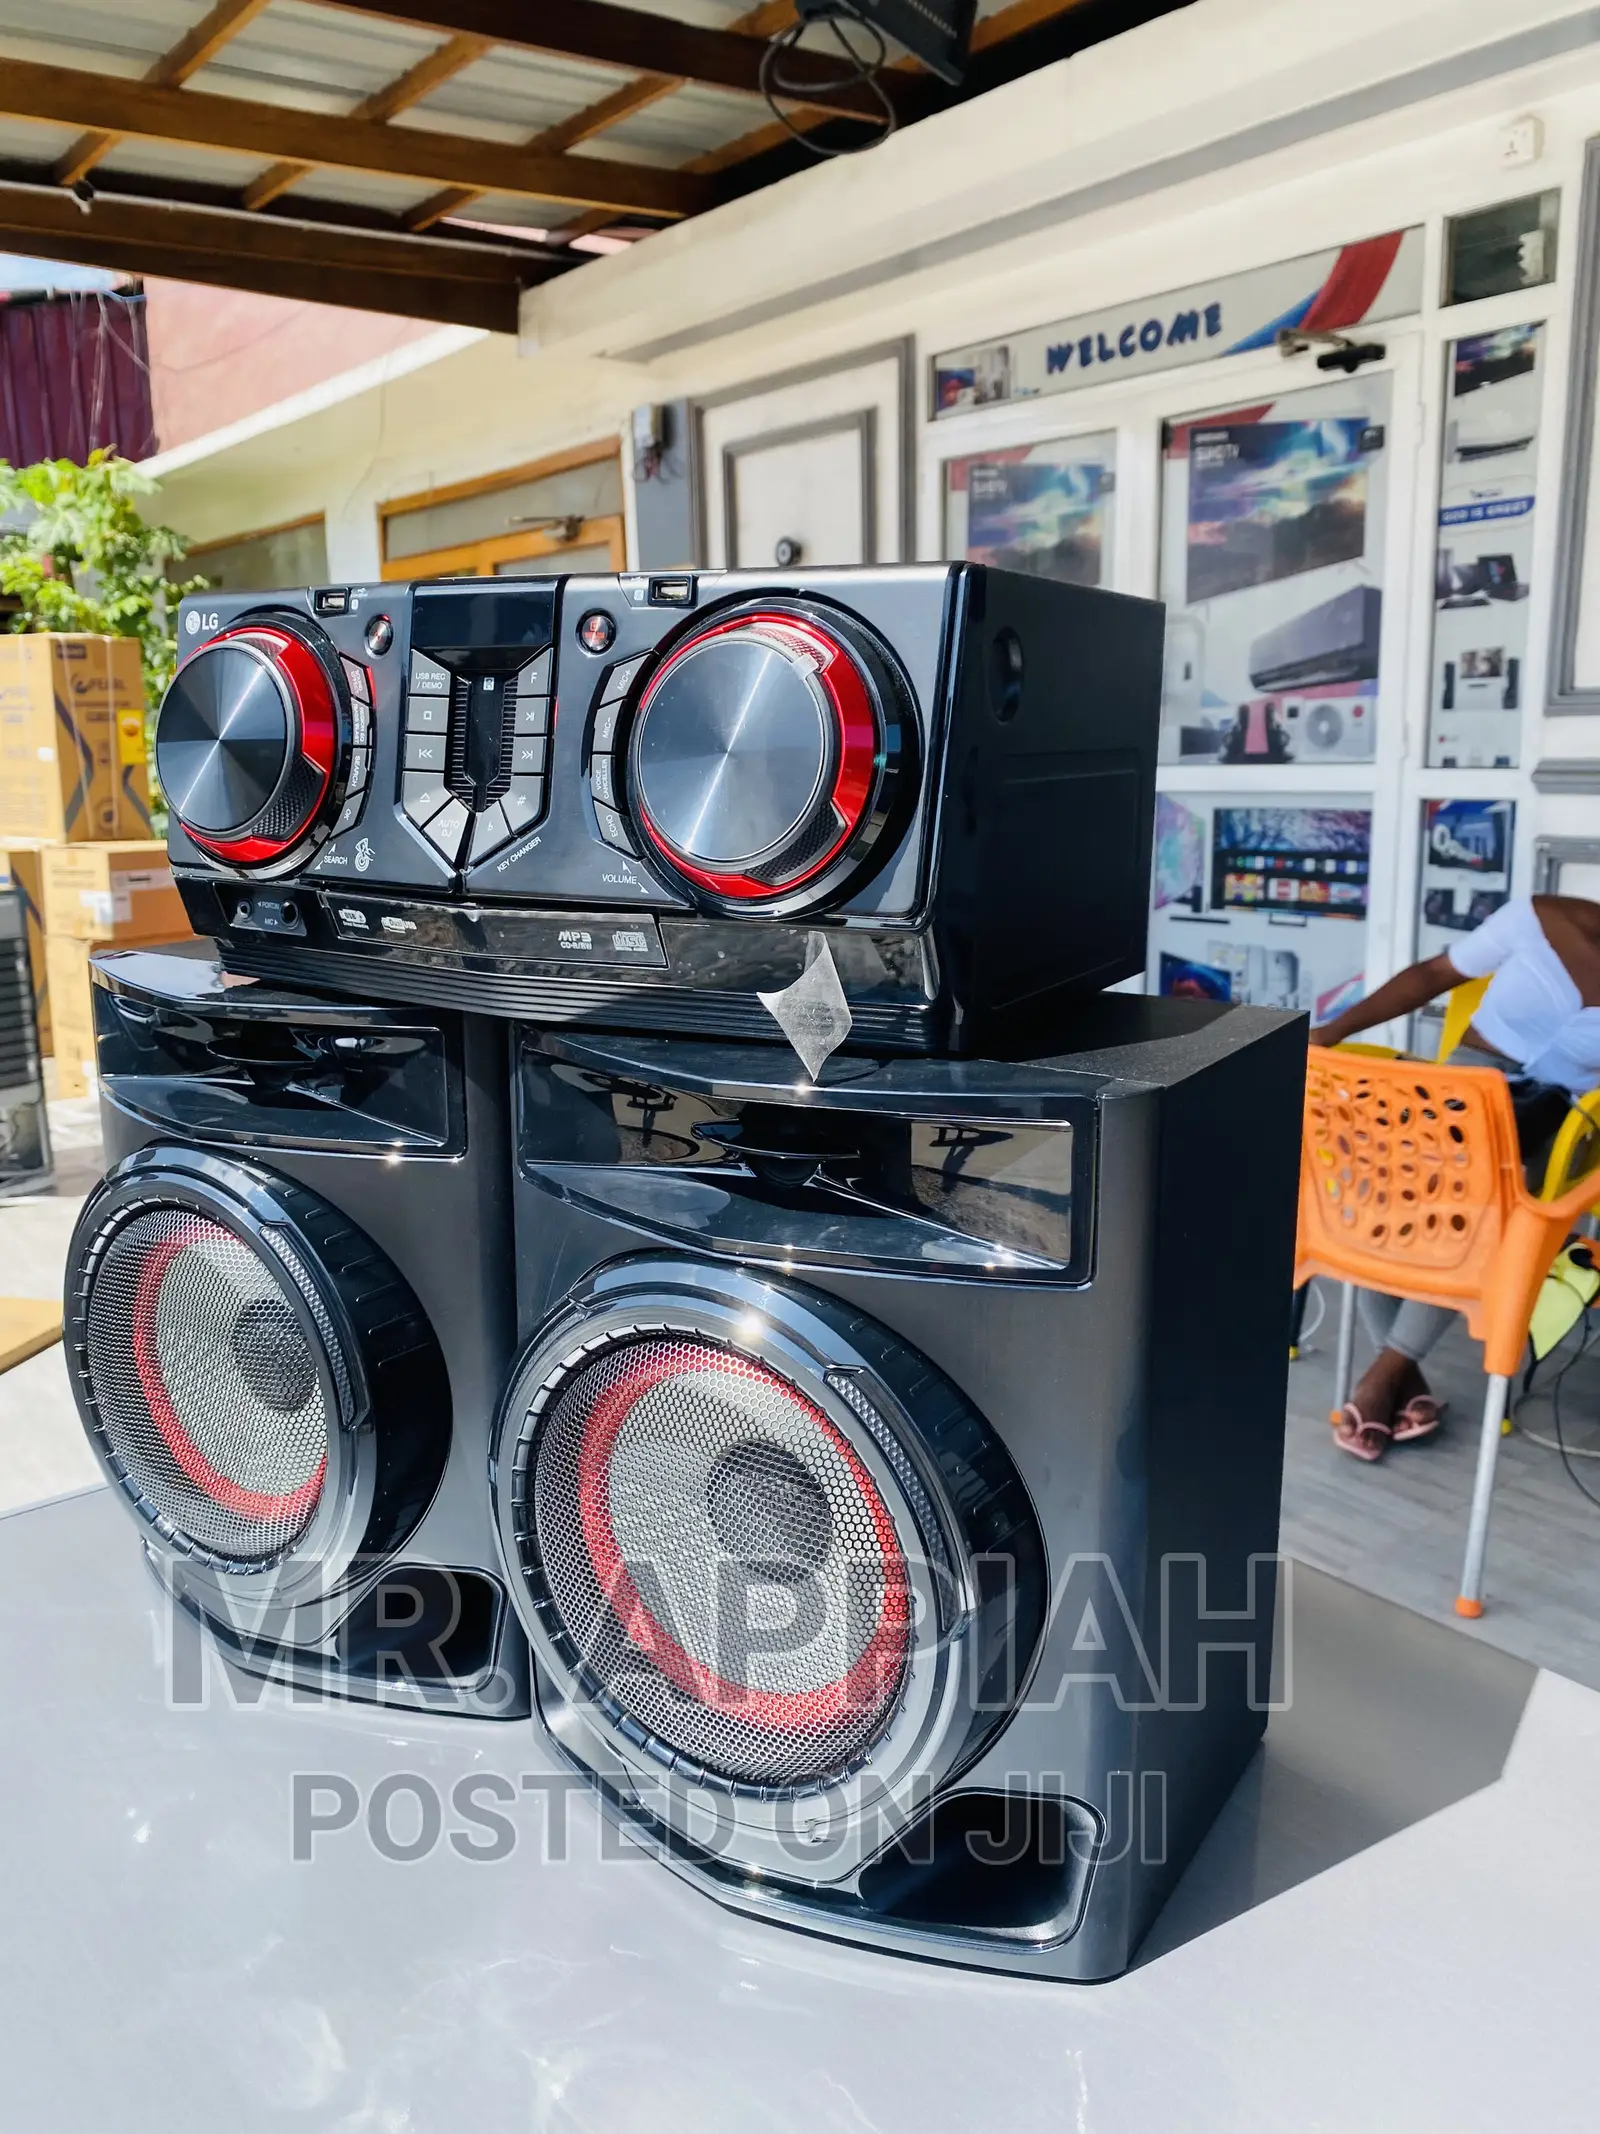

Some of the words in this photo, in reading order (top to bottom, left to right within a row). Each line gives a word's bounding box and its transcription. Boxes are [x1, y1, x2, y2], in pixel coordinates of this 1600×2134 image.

[1046, 301, 1222, 375] WELCOME
[201, 612, 219, 631] LG
[415, 672, 430, 680] USB
[430, 673, 446, 681] REC
[530, 672, 538, 684] F
[351, 755, 361, 787] SEARCH
[343, 808, 352, 821] OK
[438, 819, 460, 828] AUTO
[605, 814, 619, 838] ECHO
[442, 830, 452, 838] DJ
[323, 854, 348, 866] SEARCH
[496, 858, 511, 873] KEY
[510, 836, 542, 863] CHANGER
[602, 874, 638, 885] VOLUME
[558, 930, 592, 942] MP3
